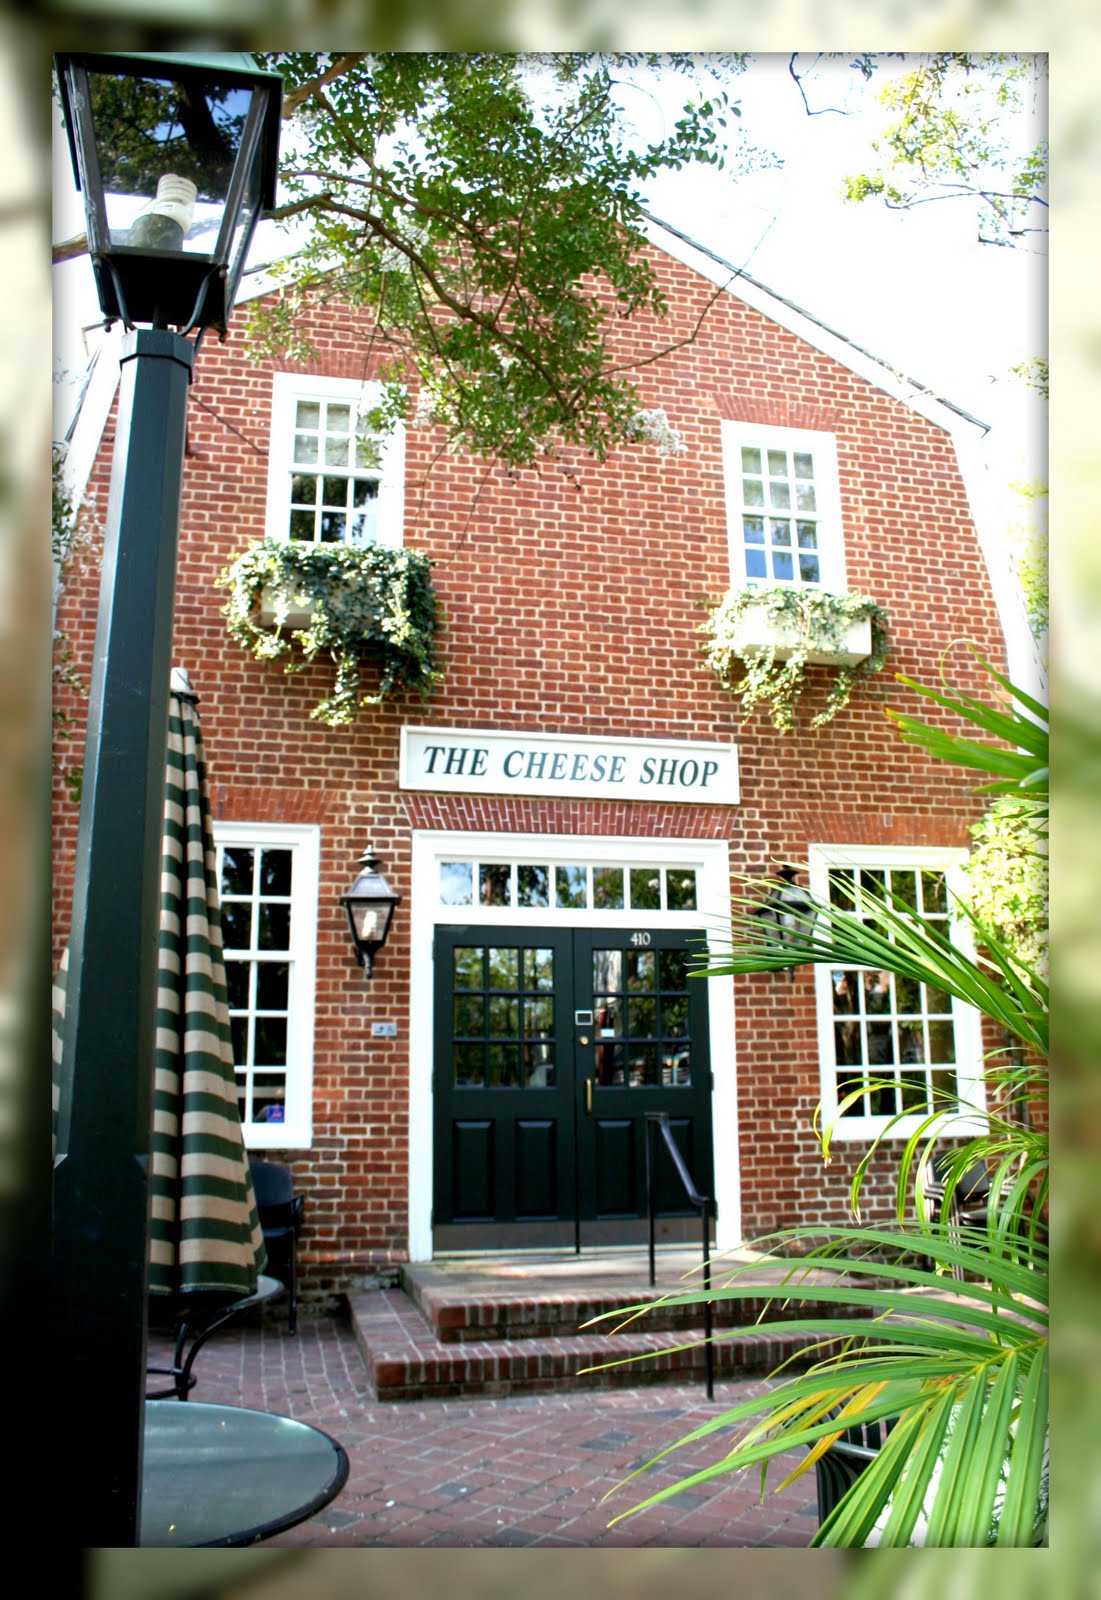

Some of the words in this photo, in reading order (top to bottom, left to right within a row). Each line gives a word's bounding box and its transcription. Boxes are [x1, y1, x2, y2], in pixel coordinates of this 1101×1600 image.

[424, 746, 489, 776] THE
[503, 750, 627, 783] CHEESE
[639, 757, 719, 788] SHOP
[630, 932, 651, 946] 410
